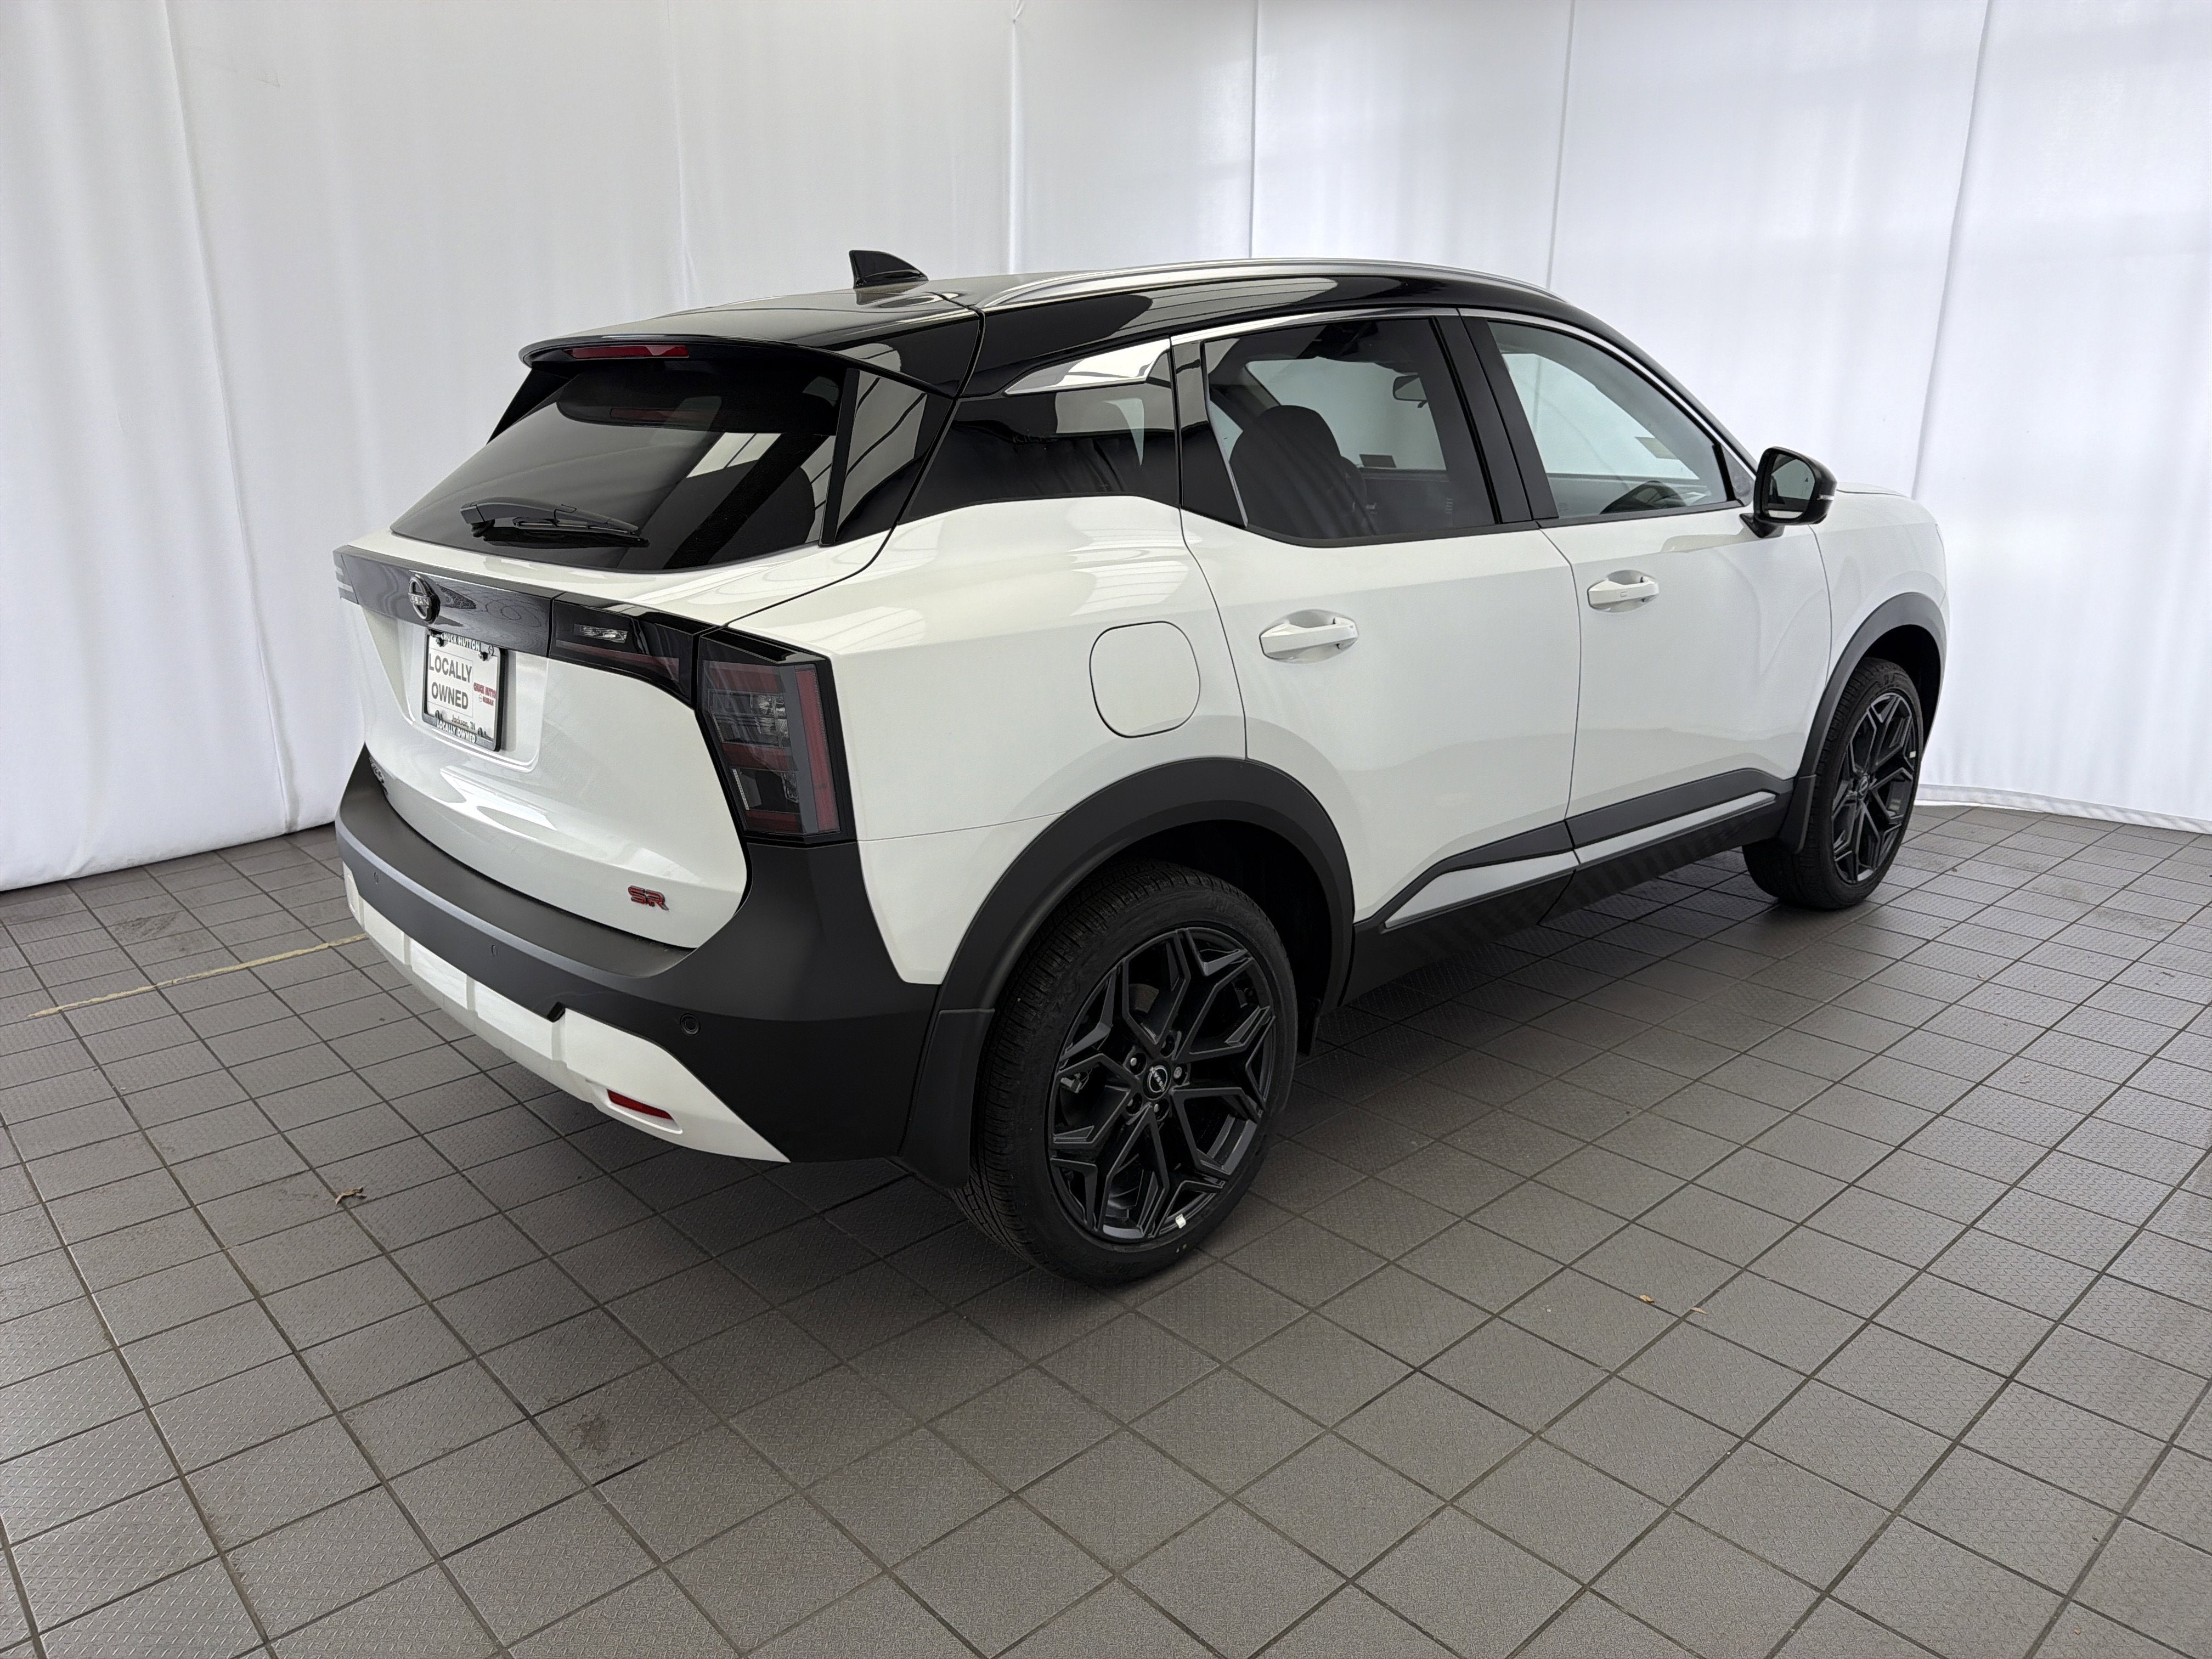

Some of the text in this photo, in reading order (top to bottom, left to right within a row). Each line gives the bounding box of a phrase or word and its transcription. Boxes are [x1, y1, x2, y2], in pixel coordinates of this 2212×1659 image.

[441, 632, 481, 652] CHUCK HUTTON
[429, 653, 472, 684] LOCALLY
[431, 681, 469, 710] OWNED
[437, 719, 477, 743] LOCALLY OWNED
[628, 885, 669, 911] SR
